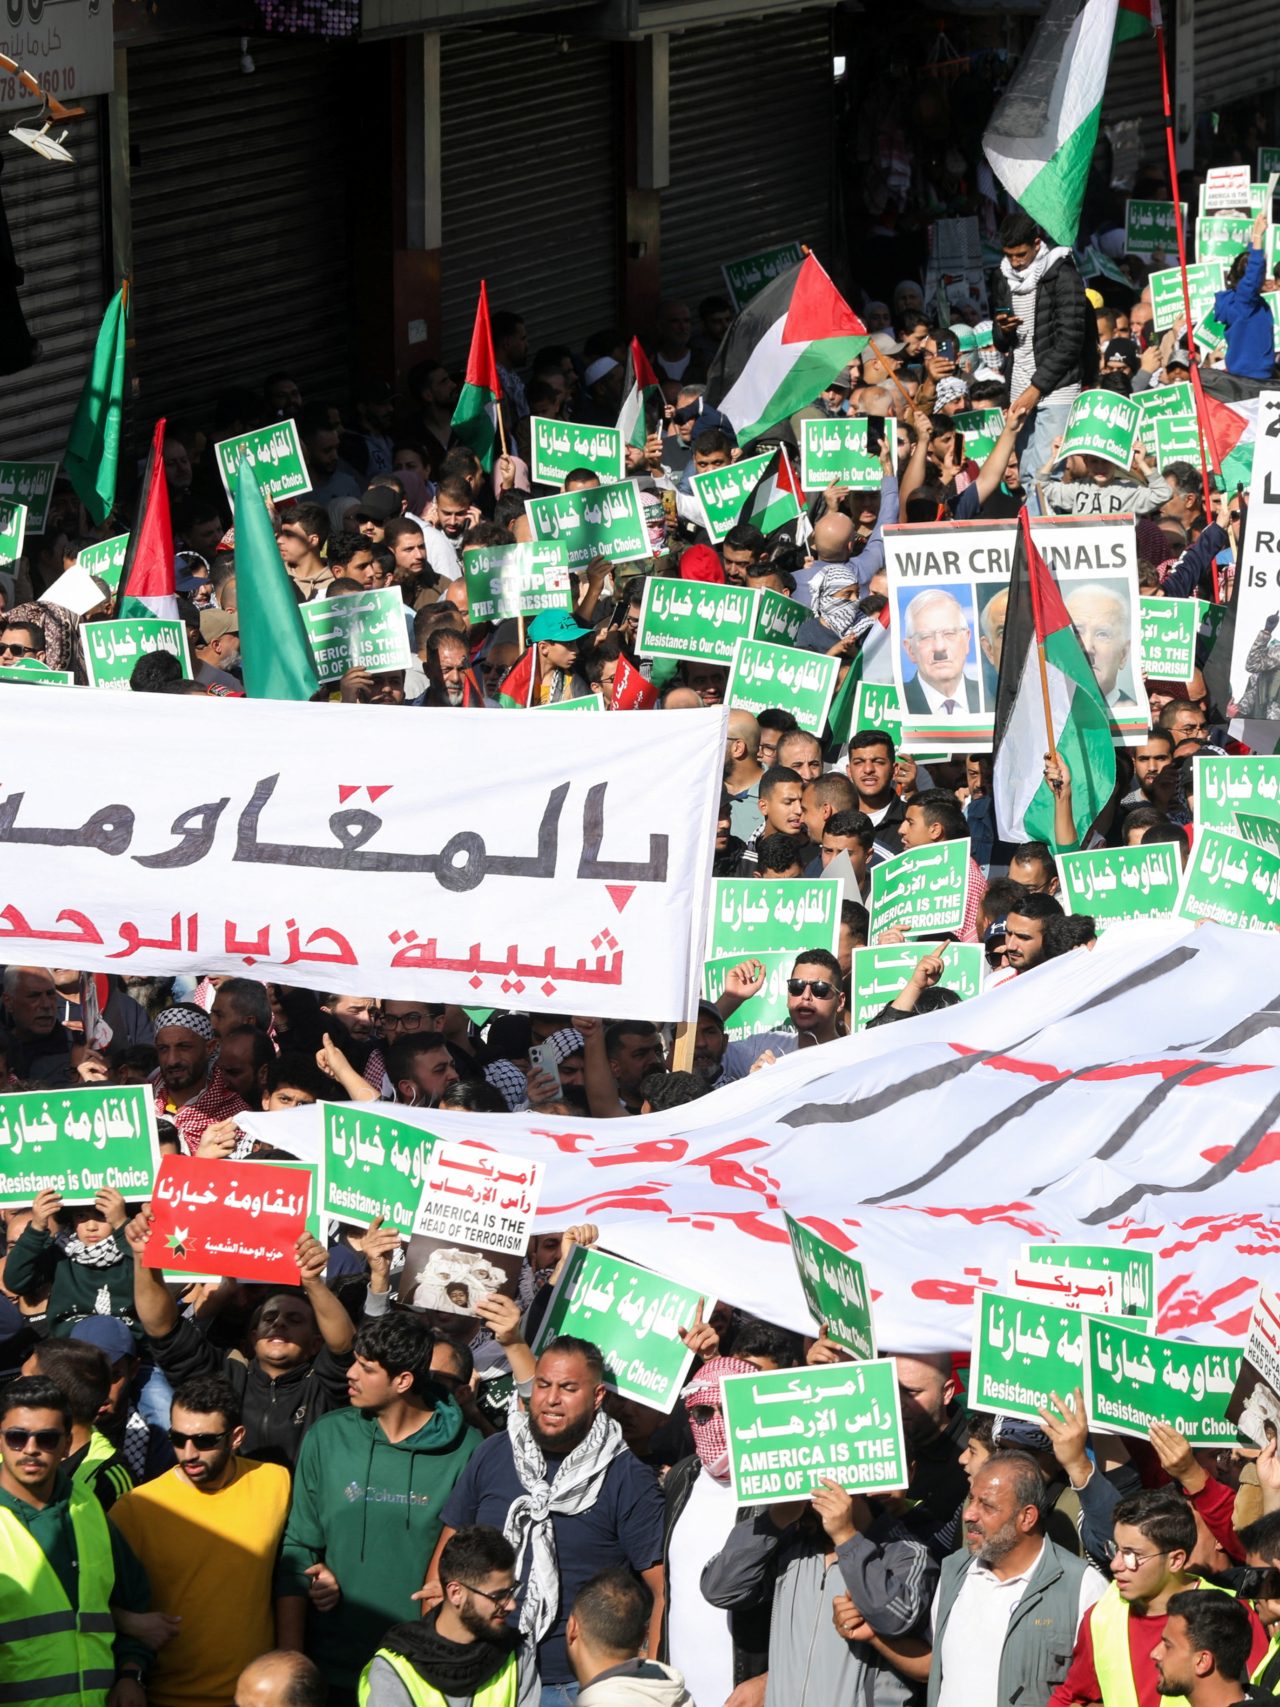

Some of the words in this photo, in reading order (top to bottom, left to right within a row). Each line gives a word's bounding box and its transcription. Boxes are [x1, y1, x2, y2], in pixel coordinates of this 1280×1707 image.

[63, 67, 75, 89] 10
[539, 425, 570, 456] خيارنا
[574, 430, 616, 462] المقاومة
[809, 426, 840, 458] خيارنا
[852, 469, 864, 481] Our
[536, 500, 580, 538] خيارنا
[584, 488, 633, 528] المقاومة
[599, 542, 612, 555] Our
[614, 536, 642, 552] Choice
[895, 550, 961, 577] WAR
[1248, 566, 1267, 588] Is
[651, 585, 693, 622] خيارنا
[697, 589, 749, 628] المقاومة
[645, 631, 688, 648] Resistance
[699, 637, 713, 653] Our
[739, 647, 774, 686] خيارنا
[1205, 765, 1252, 806] خيارنا
[885, 848, 949, 880] أمريكا
[1069, 856, 1116, 900] خيارنا
[1119, 852, 1172, 895] المقاومة
[1200, 838, 1248, 888] خيارنا
[720, 885, 770, 931] خيارنا
[774, 884, 831, 930] المقاومة
[871, 899, 913, 927] AMERICA
[916, 897, 930, 913] IS
[934, 893, 961, 912] THE
[1186, 894, 1238, 926] Resistance
[224, 917, 358, 966] حزب
[390, 926, 624, 996] شبيبة
[63, 1097, 140, 1149] المقاومة
[331, 1114, 386, 1173] خيارنا
[0, 1172, 65, 1193] Resistance
[81, 1168, 103, 1189] Our
[106, 1166, 149, 1188] Choice
[438, 1150, 536, 1187] أمريكا
[157, 1176, 218, 1212] خيارنا
[223, 1181, 304, 1217] المقاومة
[329, 1182, 381, 1217] Resistance
[393, 1202, 414, 1226] Our
[500, 1190, 532, 1214] رأس
[420, 1218, 445, 1234] HEAD
[448, 1225, 461, 1238] OF
[465, 1227, 522, 1251] TERRORISM
[424, 1201, 480, 1224] AMERICA
[483, 1214, 496, 1228] IS
[501, 1218, 526, 1234] THE
[204, 1237, 238, 1256] الشعبية
[238, 1241, 266, 1259] الوحدة
[265, 1245, 284, 1261] حزب
[565, 1259, 619, 1319] خيارنا
[1014, 1269, 1114, 1297] أمريكا
[988, 1303, 1051, 1365] خيارنا
[627, 1359, 668, 1393] Choice
[1096, 1330, 1156, 1389] خيارنا
[752, 1368, 865, 1404] أمريكا
[983, 1374, 1048, 1408] Resistance
[735, 1408, 838, 1444] الإرهاب
[845, 1398, 892, 1433] رأس
[1175, 1417, 1198, 1436] Our
[740, 1446, 825, 1473] AMERICA
[831, 1443, 849, 1462] IS
[854, 1438, 895, 1459] THE
[741, 1474, 781, 1495] HEAD
[785, 1471, 804, 1490] OF
[807, 1461, 897, 1488] TERRORISM
[366, 1487, 430, 1506] Columbia
